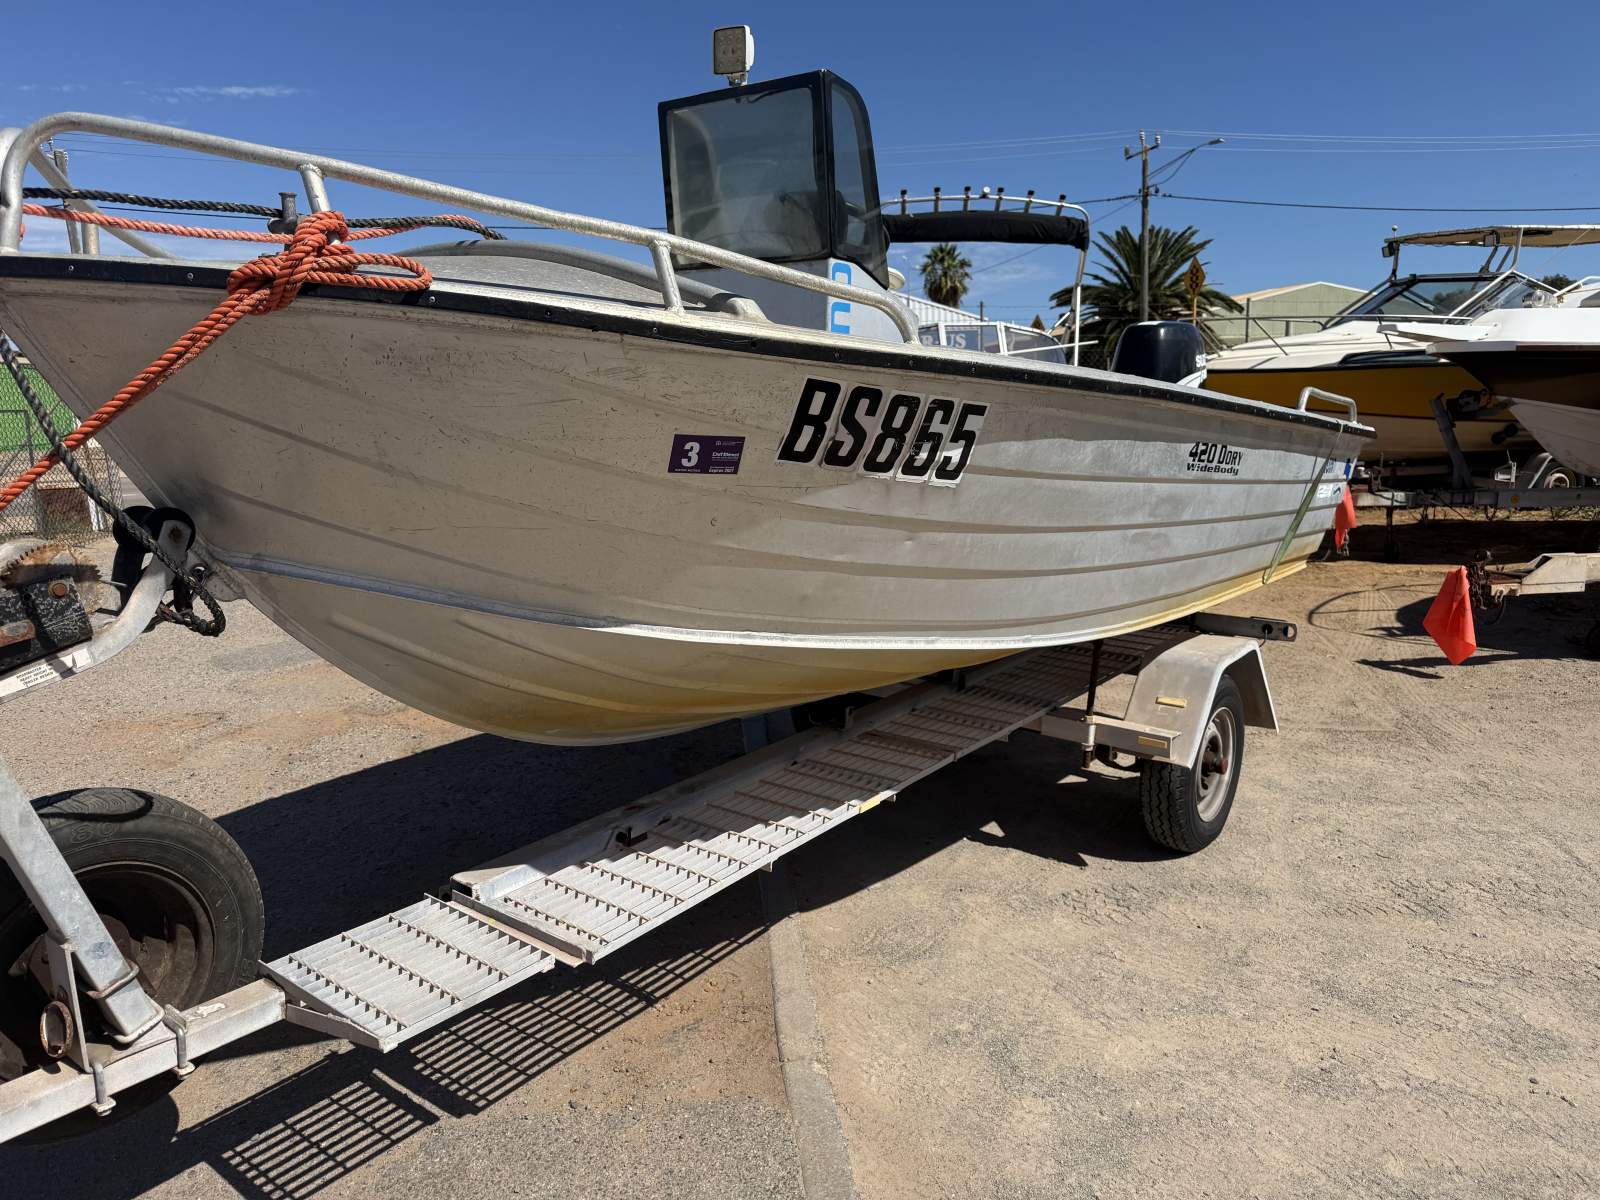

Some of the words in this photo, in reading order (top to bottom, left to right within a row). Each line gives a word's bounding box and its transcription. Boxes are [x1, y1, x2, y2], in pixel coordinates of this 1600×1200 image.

[777, 377, 989, 480] BS865
[681, 441, 700, 467] 3
[1188, 441, 1218, 463] 420
[1186, 462, 1239, 476] WideBody
